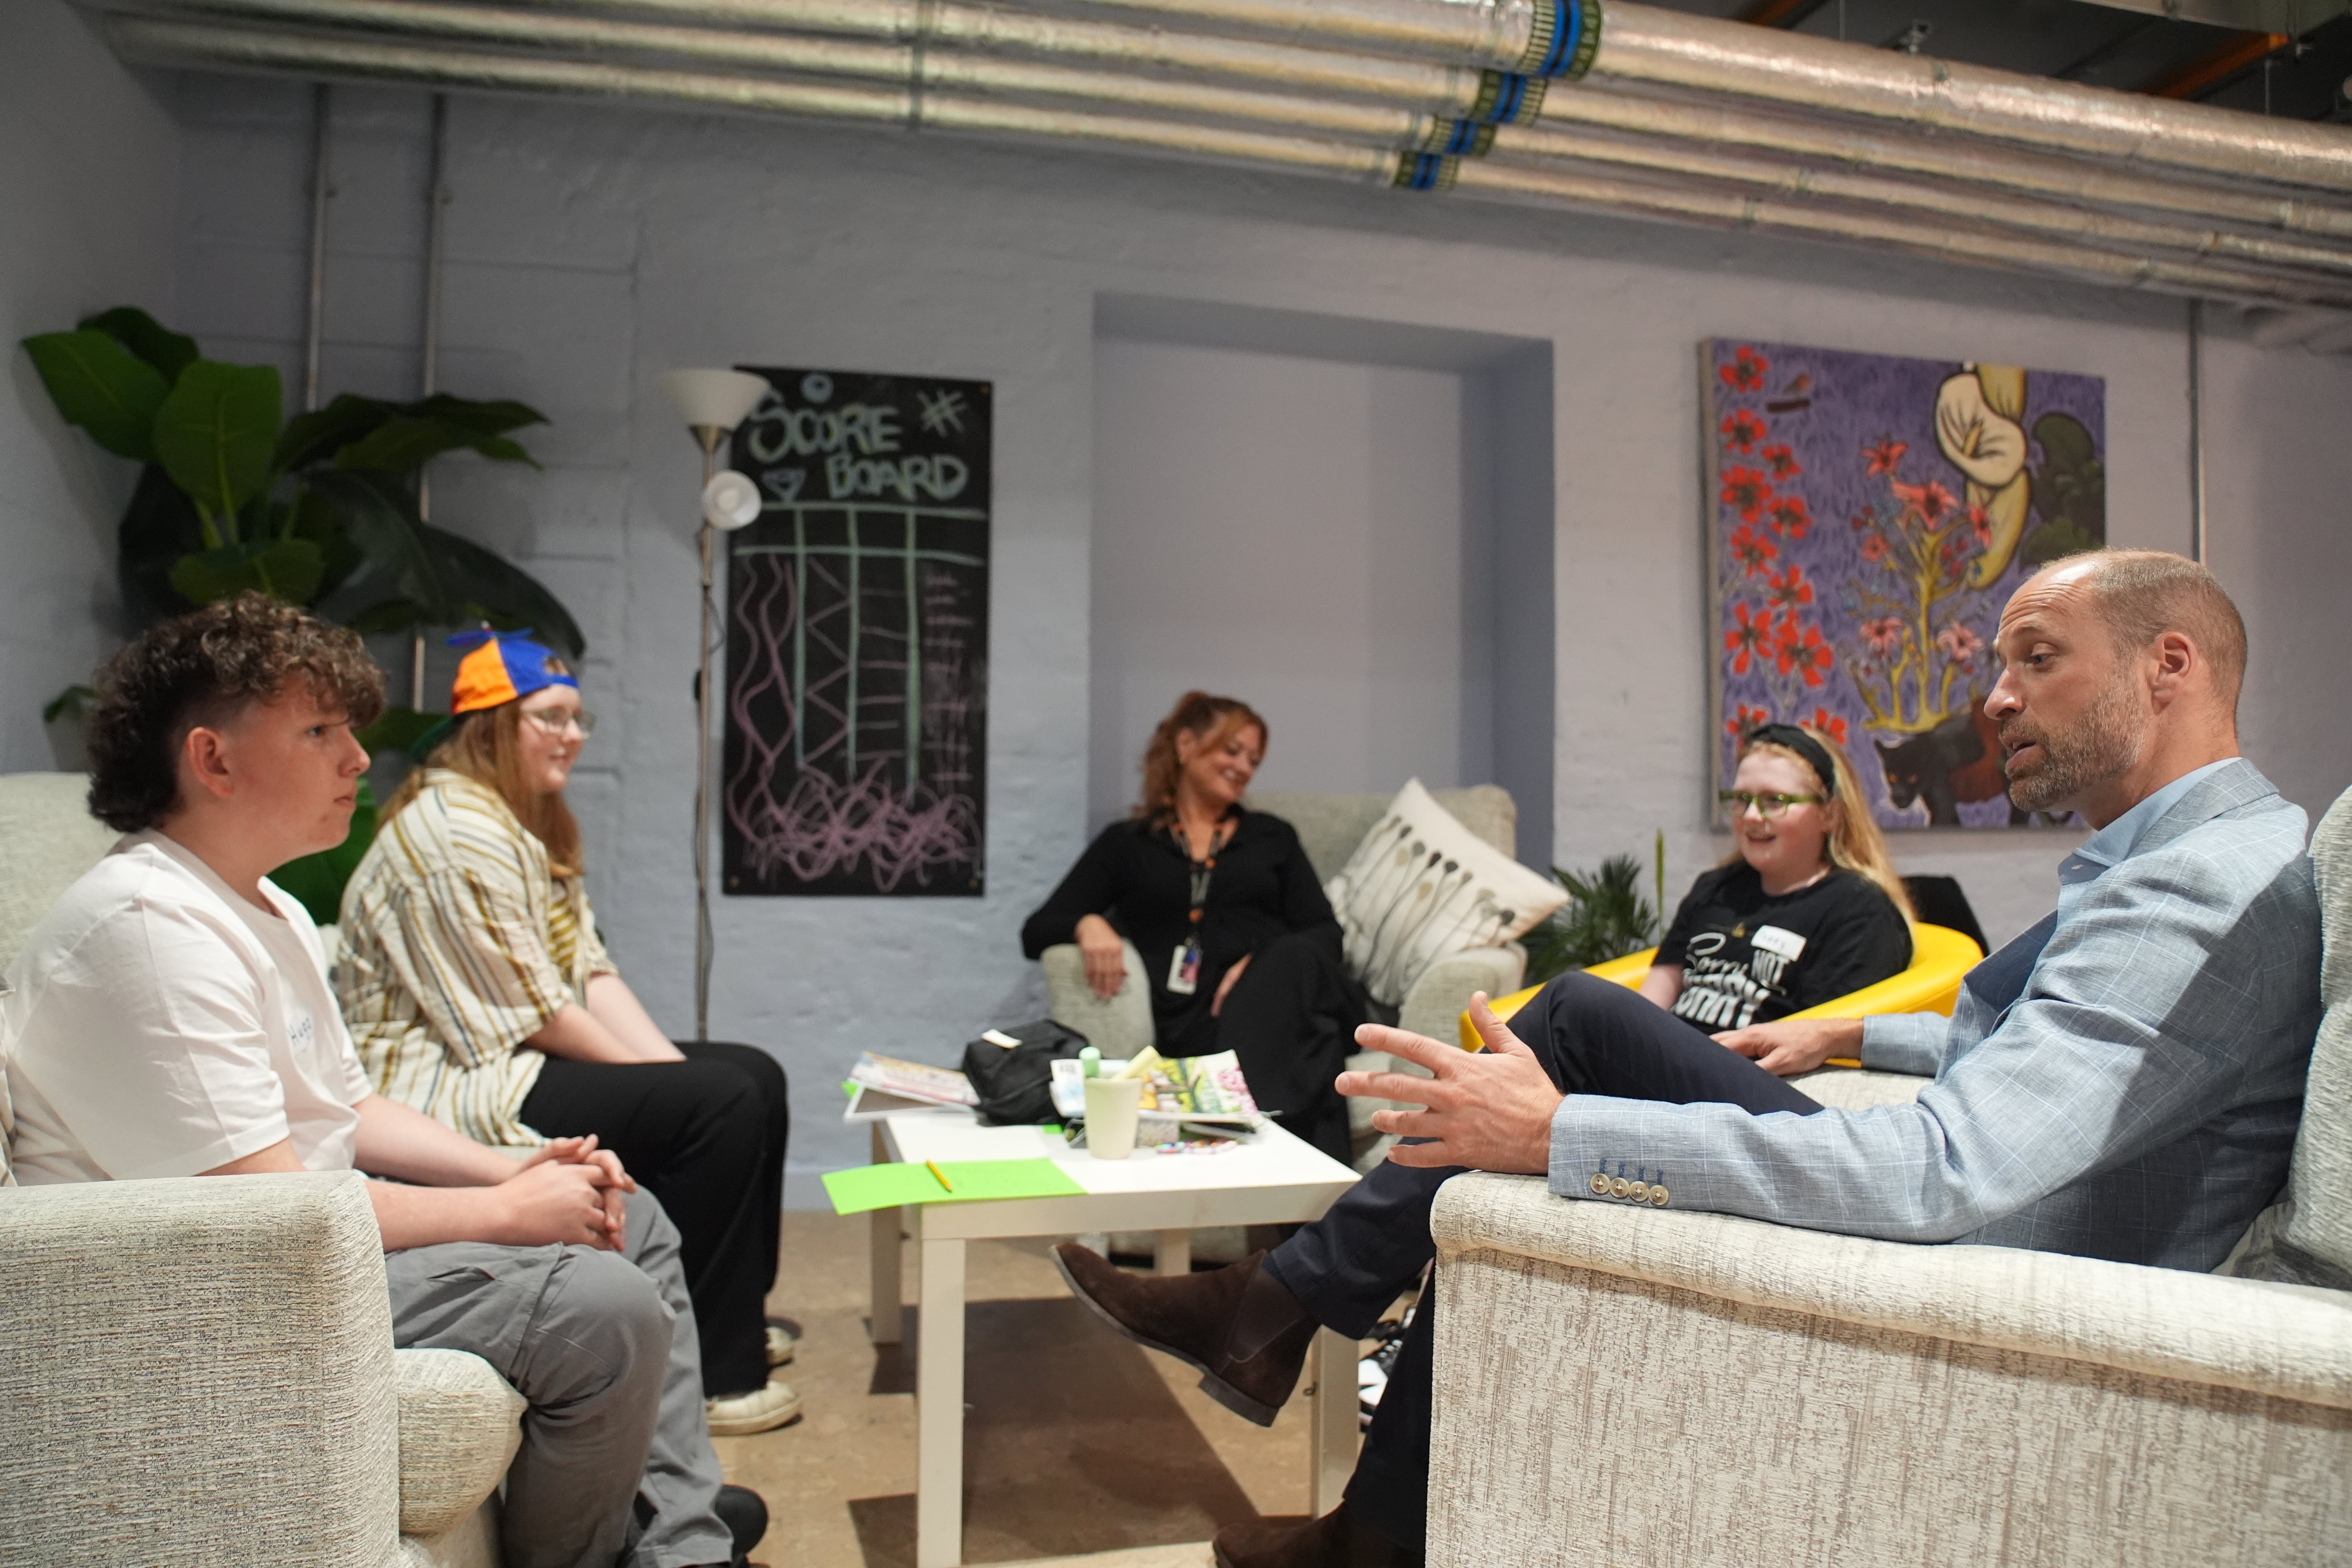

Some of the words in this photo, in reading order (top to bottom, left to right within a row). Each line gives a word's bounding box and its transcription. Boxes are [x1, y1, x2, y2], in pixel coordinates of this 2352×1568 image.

[748, 390, 902, 464] SCORE
[826, 451, 969, 501] BOARD
[1751, 949, 1791, 988] NOT
